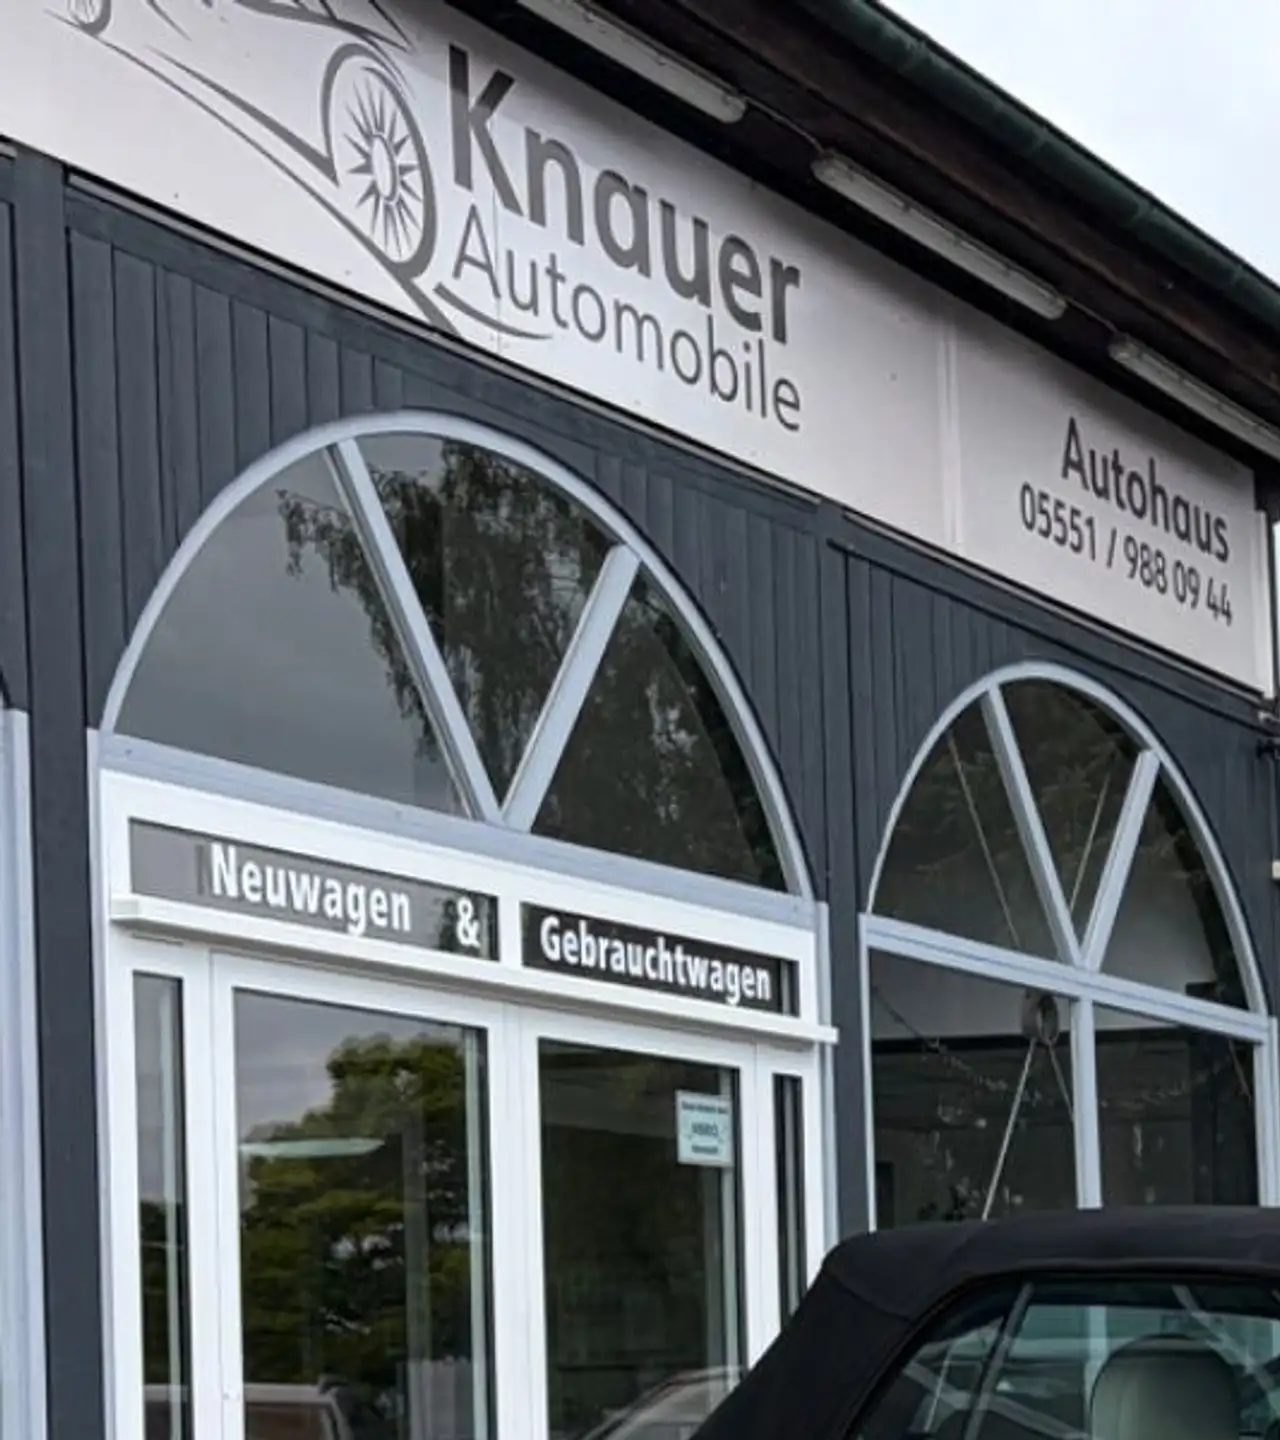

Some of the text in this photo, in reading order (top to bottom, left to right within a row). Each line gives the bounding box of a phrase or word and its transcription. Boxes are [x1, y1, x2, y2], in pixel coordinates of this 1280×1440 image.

[449, 43, 801, 346] Knauer
[452, 202, 801, 432] Automobile
[1020, 481, 1232, 626] 05551 / 988 09 44
[1061, 416, 1230, 563] Autohaus
[211, 842, 481, 947] Neuwagen &
[540, 915, 772, 1006] Gebrauchtwagen
